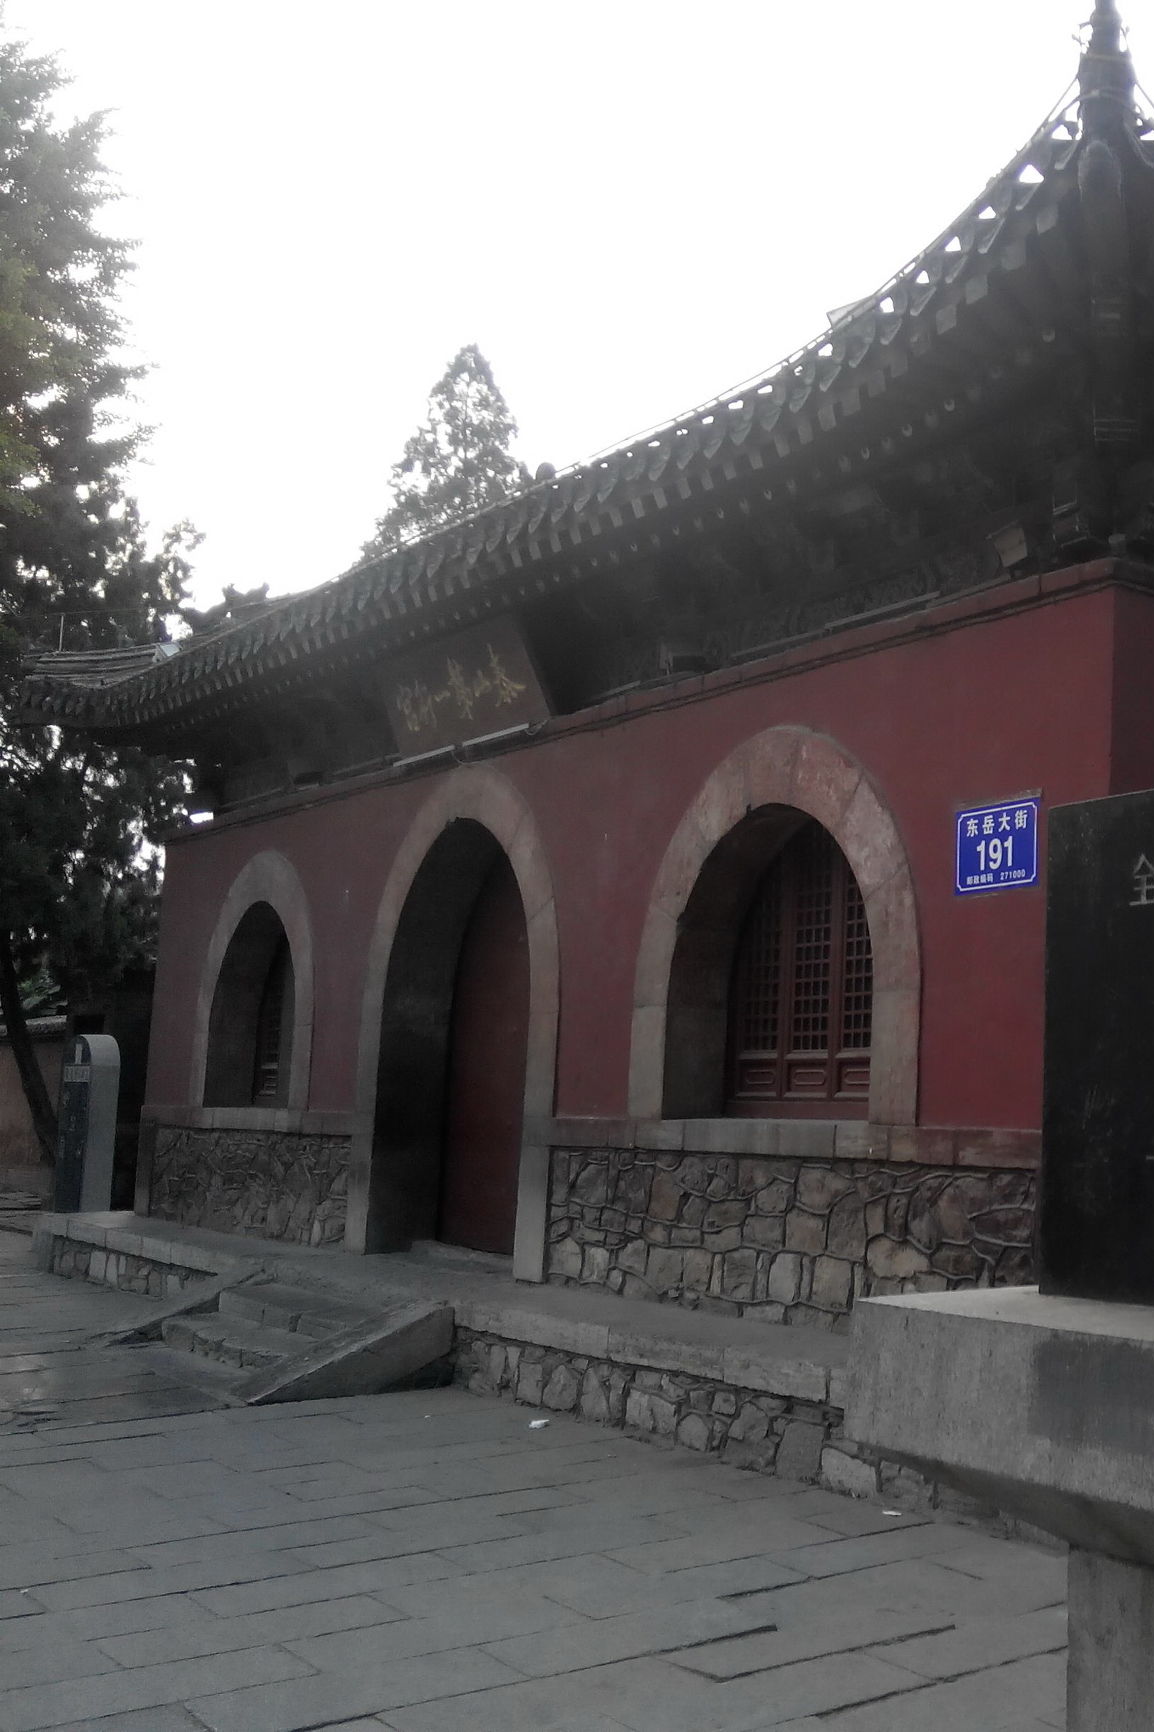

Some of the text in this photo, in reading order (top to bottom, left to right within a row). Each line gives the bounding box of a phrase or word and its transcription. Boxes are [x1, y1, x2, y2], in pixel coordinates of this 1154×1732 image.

[966, 809, 1028, 837] 东岳大街
[976, 835, 1013, 871] 191
[1000, 869, 1026, 881] 271000
